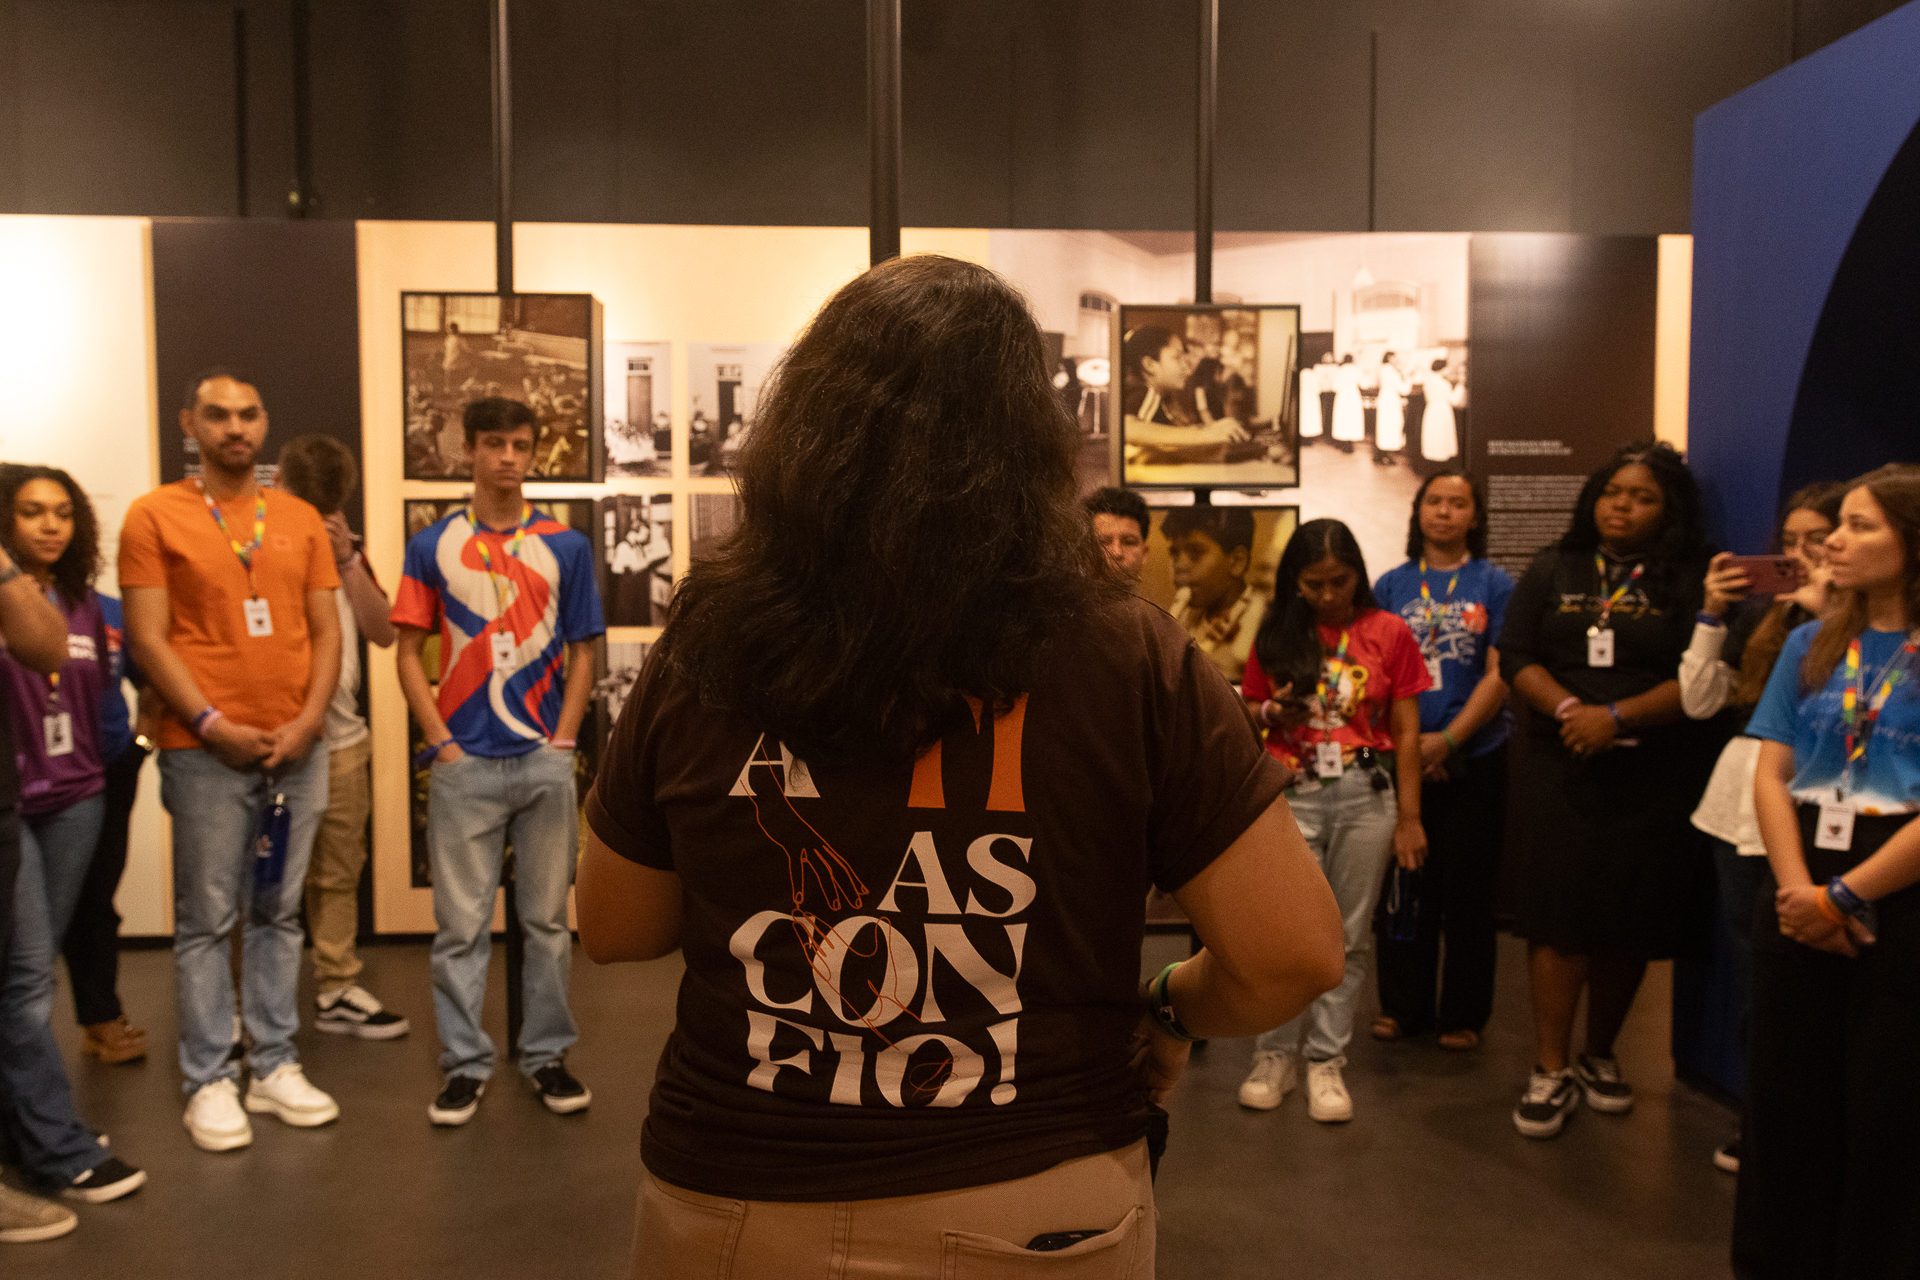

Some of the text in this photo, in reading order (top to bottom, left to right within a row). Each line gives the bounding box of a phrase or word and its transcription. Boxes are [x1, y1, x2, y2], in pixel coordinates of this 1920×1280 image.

[728, 731, 821, 798] A
[877, 831, 1037, 918] AS
[729, 910, 1028, 1028] CON
[746, 1009, 1019, 1108] FIO!
